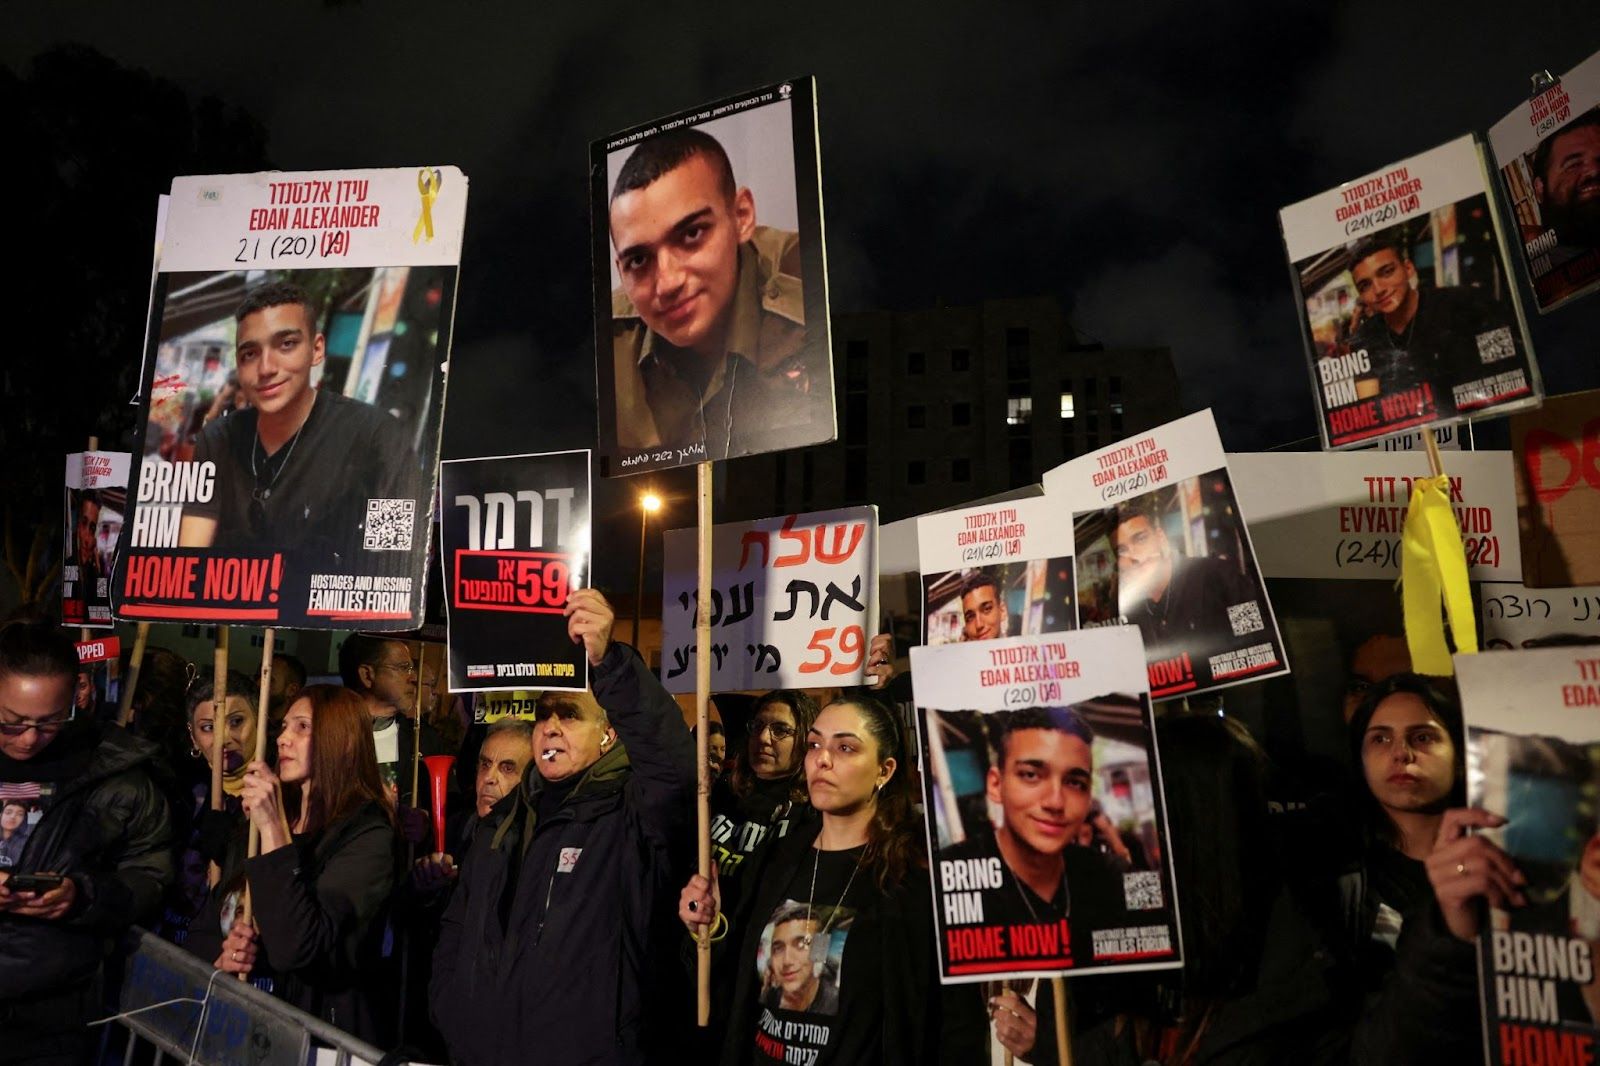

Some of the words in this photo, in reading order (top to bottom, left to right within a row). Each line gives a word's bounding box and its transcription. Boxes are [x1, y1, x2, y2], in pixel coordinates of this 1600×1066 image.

[1341, 177, 1384, 204] אלכסנדר
[1385, 167, 1409, 187] עידן
[269, 182, 330, 205] אלכסנדר
[336, 180, 369, 204] עידן
[1335, 202, 1362, 222] EDAN
[1364, 178, 1423, 211] ALEXANDER
[249, 207, 289, 231] EDAN
[291, 205, 380, 229] ALEXANDER
[234, 238, 260, 263] 21
[270, 235, 317, 260] (20)
[1524, 228, 1558, 260] BRING
[1318, 349, 1371, 385] BRING
[1323, 378, 1359, 409] HIM
[1329, 401, 1381, 435] HOME
[1381, 382, 1435, 422] NOW!
[1136, 438, 1156, 456] עידן
[1417, 425, 1452, 444] עמי
[1092, 470, 1117, 487] EDAN
[1118, 449, 1169, 477] ALEXANDER
[1097, 448, 1136, 469] אלכסנדר
[137, 460, 216, 504] BRING
[1364, 477, 1396, 503] דוד
[131, 506, 183, 548] HIM
[455, 488, 575, 552] דרמר
[965, 512, 997, 529] אלכסנדר
[1000, 509, 1017, 526] עידן
[1340, 507, 1408, 533] EVYAT
[1457, 507, 1492, 533] VID
[738, 513, 866, 573] שלח
[958, 531, 977, 546] EDAN
[979, 524, 1025, 543] ALEXANDER
[1466, 536, 1500, 568] 22)
[124, 555, 200, 600] HOME
[203, 553, 284, 603] NOW!
[310, 574, 354, 590] HOSTAGES
[354, 575, 373, 590] AND
[373, 577, 412, 592] MISSING
[498, 559, 515, 581] או
[517, 560, 570, 607] 59
[308, 589, 364, 612] FAMILIES
[365, 591, 411, 613] FORUM
[461, 580, 515, 603] תתפטר
[678, 580, 755, 630] עמי
[773, 574, 866, 622] את
[1487, 595, 1551, 618] רוצה
[667, 643, 729, 680] יוע
[747, 643, 781, 674] מי
[798, 624, 866, 676] 59
[989, 645, 1038, 667] אלכסנדר
[1040, 643, 1067, 663] עידן
[1246, 651, 1277, 670] FORUM
[980, 668, 1010, 687] EDAN
[1014, 661, 1081, 684] ALEXANDER
[489, 699, 535, 718] פקרנו
[1003, 686, 1037, 706] (20)
[1562, 684, 1600, 708] EDA
[940, 857, 1003, 892] BRING
[943, 892, 985, 925] HIM
[947, 927, 1007, 961] HOME
[1009, 919, 1072, 956] NOW!
[1492, 931, 1593, 984] BRING
[1495, 974, 1560, 1025] HIM
[784, 1021, 830, 1045] מחזירים
[1499, 1022, 1594, 1066] HOME
